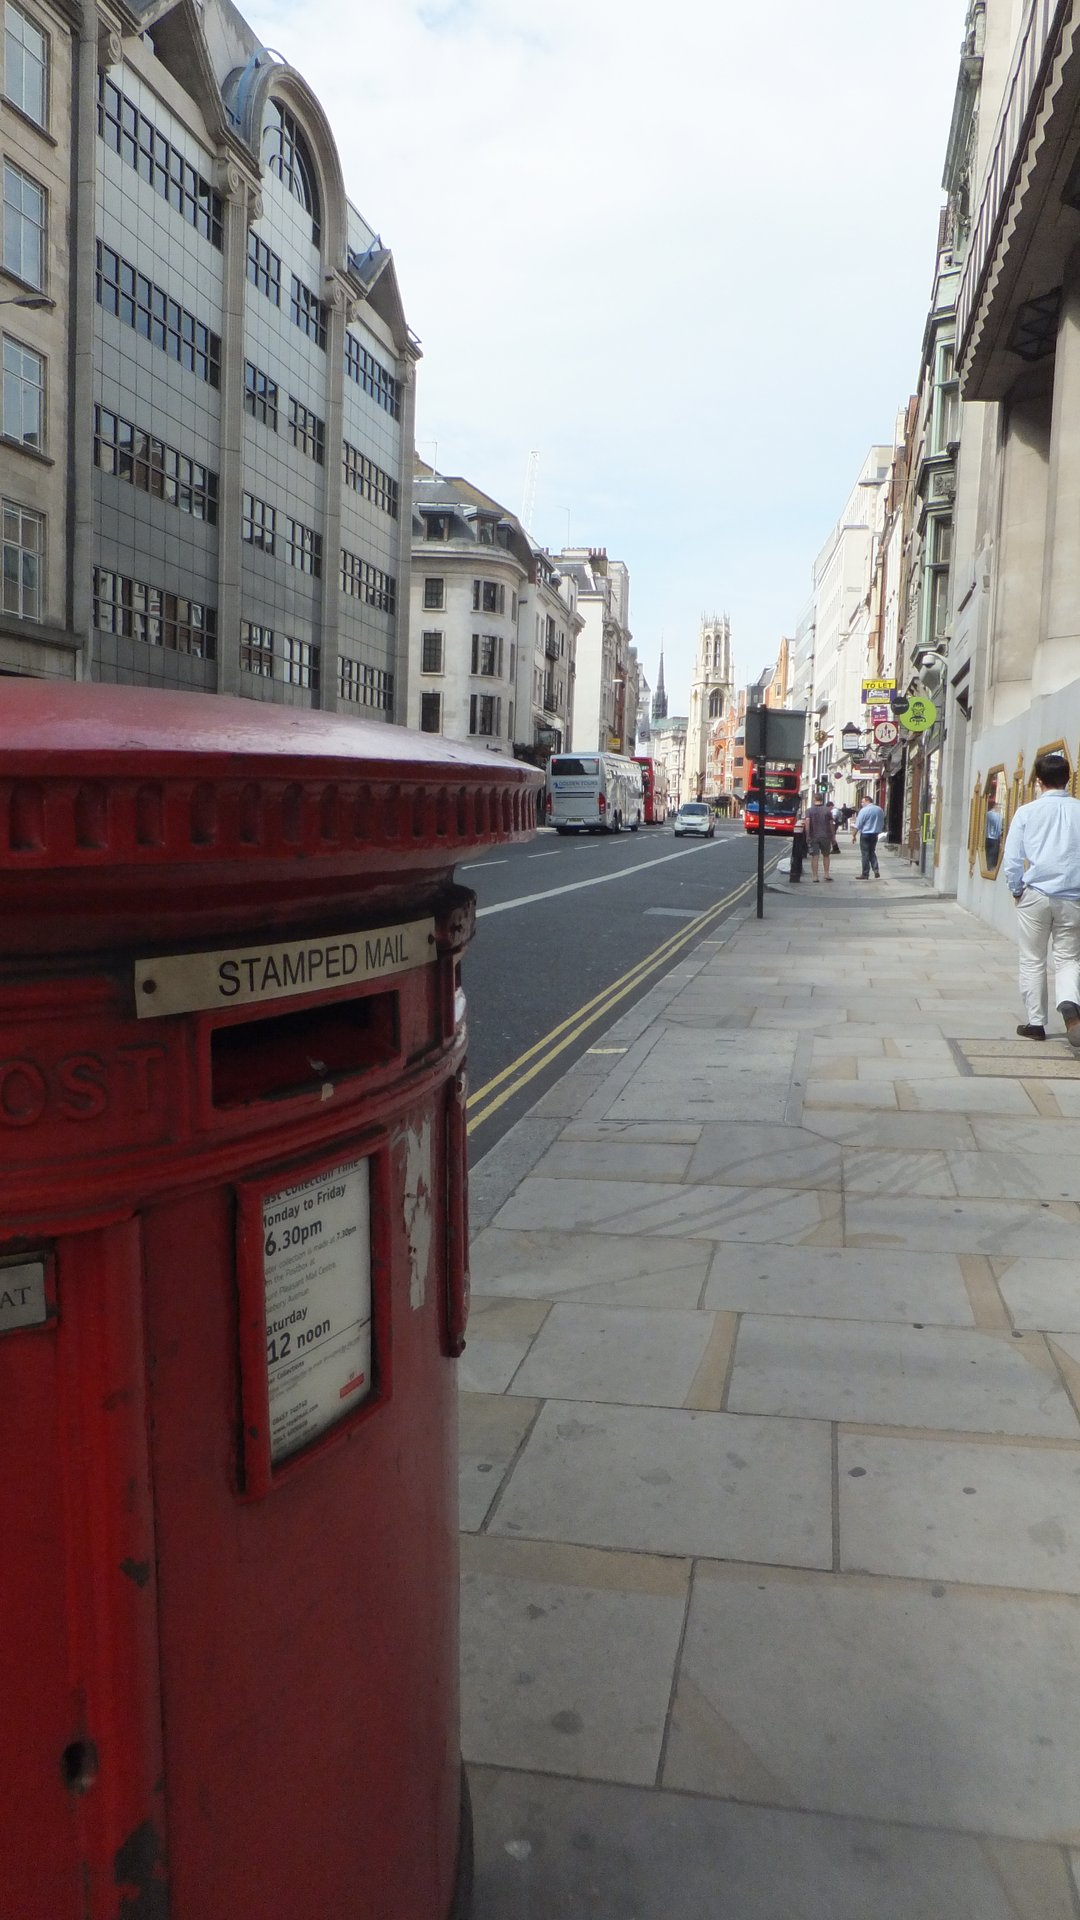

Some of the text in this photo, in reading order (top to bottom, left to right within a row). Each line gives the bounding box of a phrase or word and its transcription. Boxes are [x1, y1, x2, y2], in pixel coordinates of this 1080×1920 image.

[218, 933, 409, 997] STAMPED MAIL
[304, 1199, 314, 1211] to
[317, 1184, 347, 1205] Friday
[265, 1220, 322, 1257] 6.30pm
[267, 1319, 331, 1366] 12 noon
